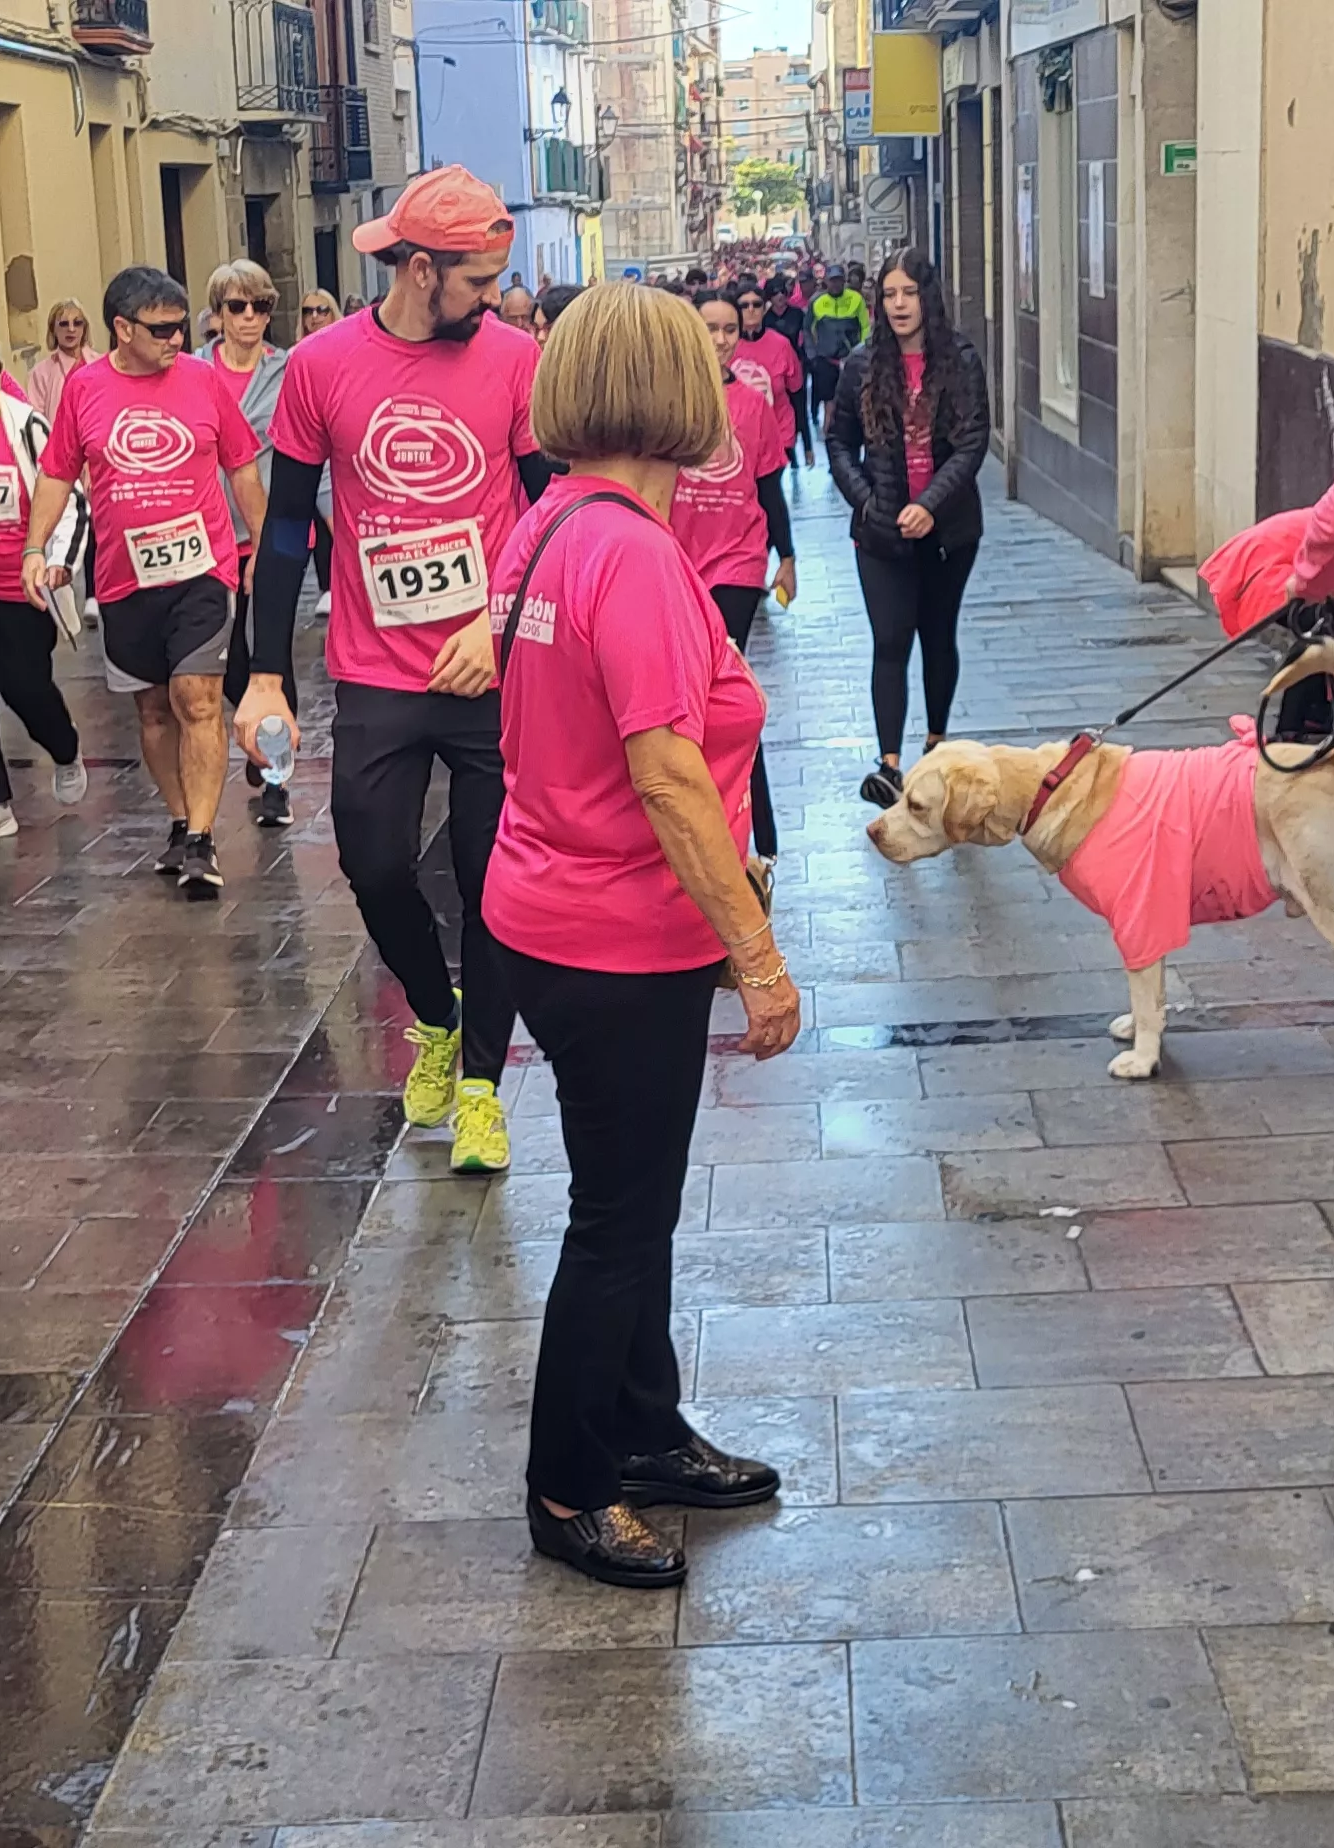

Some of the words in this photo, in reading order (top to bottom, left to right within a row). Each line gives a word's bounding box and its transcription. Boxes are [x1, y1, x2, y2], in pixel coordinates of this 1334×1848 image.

[139, 535, 202, 568] 2579
[373, 550, 413, 564] CONTRA
[414, 547, 426, 558] EL
[377, 553, 472, 600] 1931
